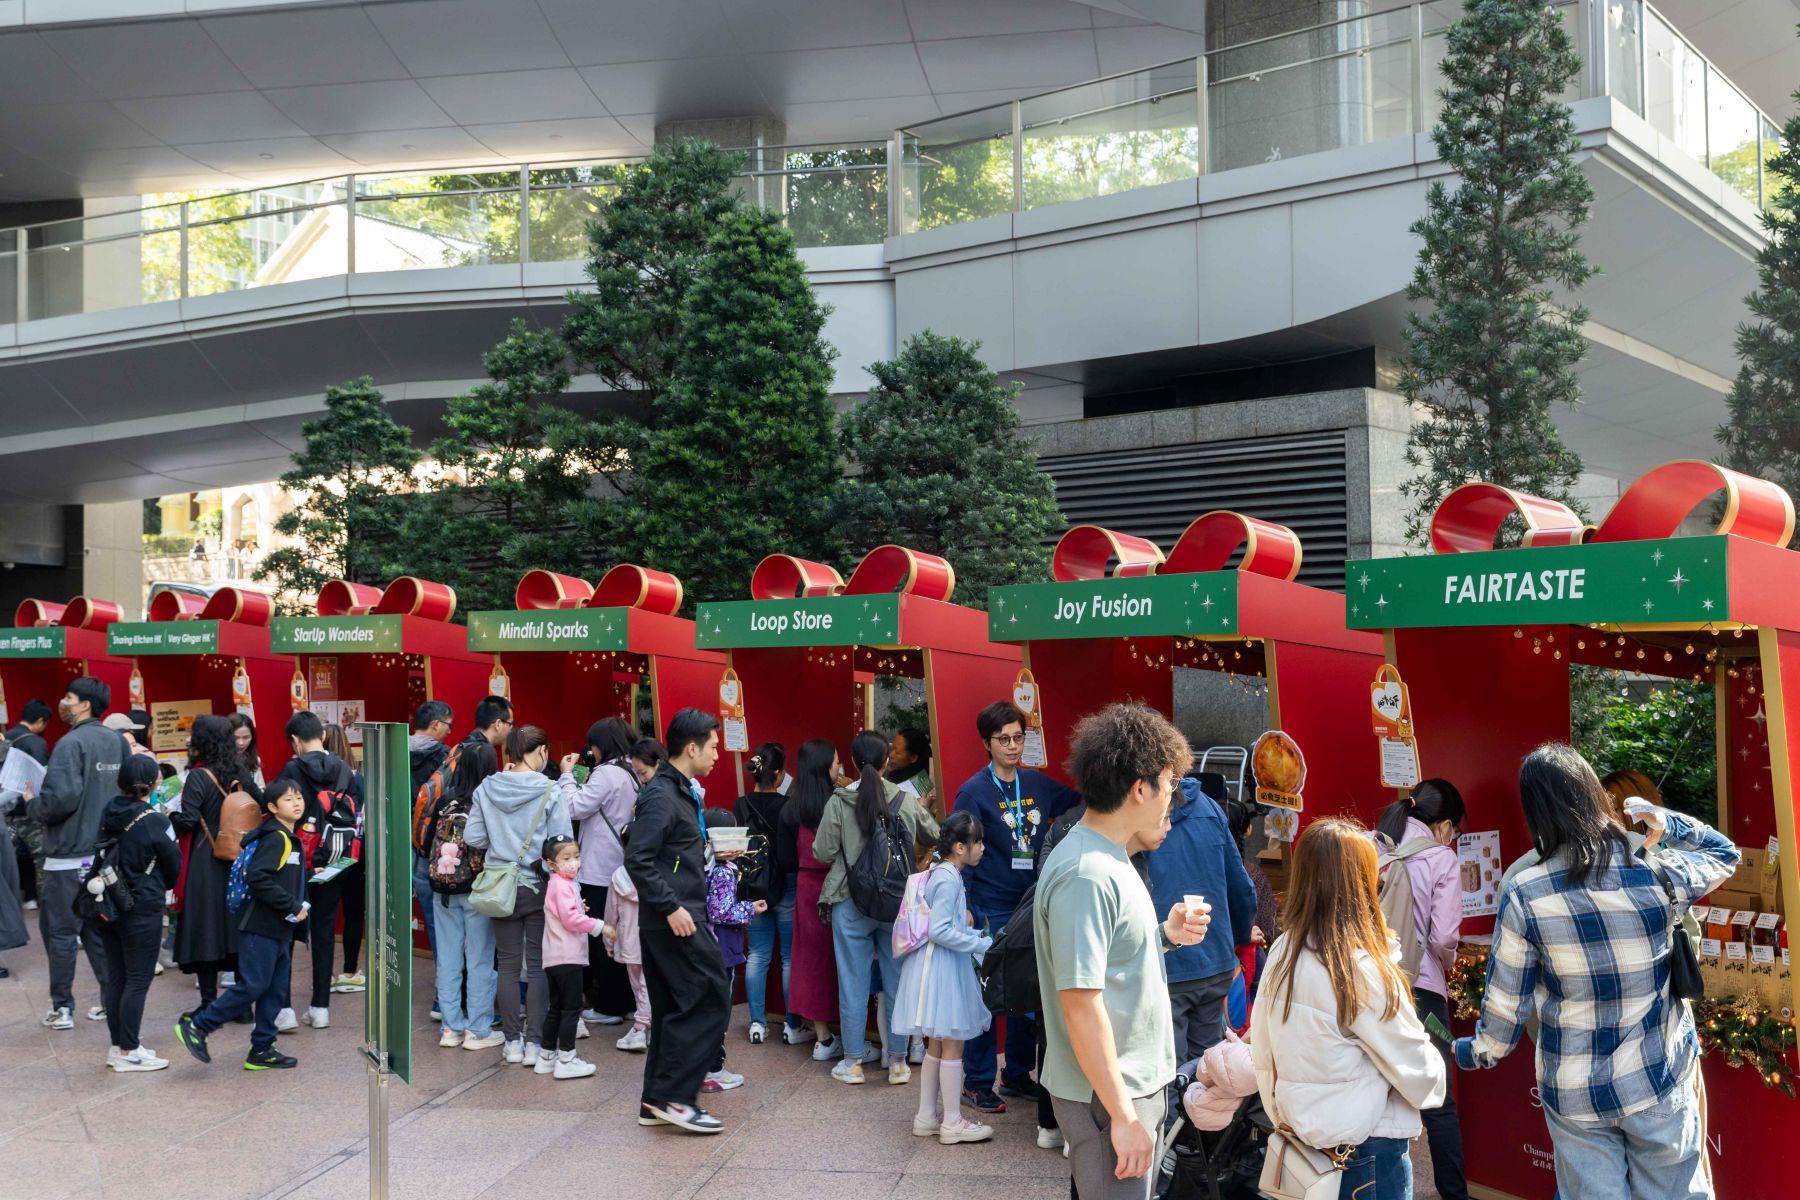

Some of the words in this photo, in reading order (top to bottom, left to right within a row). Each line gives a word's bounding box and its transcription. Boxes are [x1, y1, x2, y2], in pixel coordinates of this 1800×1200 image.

[1444, 569, 1586, 604] FAIRTASTE
[1053, 597, 1087, 625] Joy
[1092, 593, 1152, 618] Fusion
[498, 621, 544, 639] Mindful
[546, 620, 589, 643] Sparks
[751, 612, 788, 635] Loop
[792, 610, 833, 630] Store
[11, 636, 36, 652] Fingers
[37, 636, 52, 649] Plus
[133, 634, 154, 644] Kitchen
[168, 634, 181, 645] Very
[181, 633, 202, 645] Ginger
[293, 627, 326, 645] StarUp
[328, 626, 374, 642] Wonders
[1523, 1143, 1554, 1161] Champi
